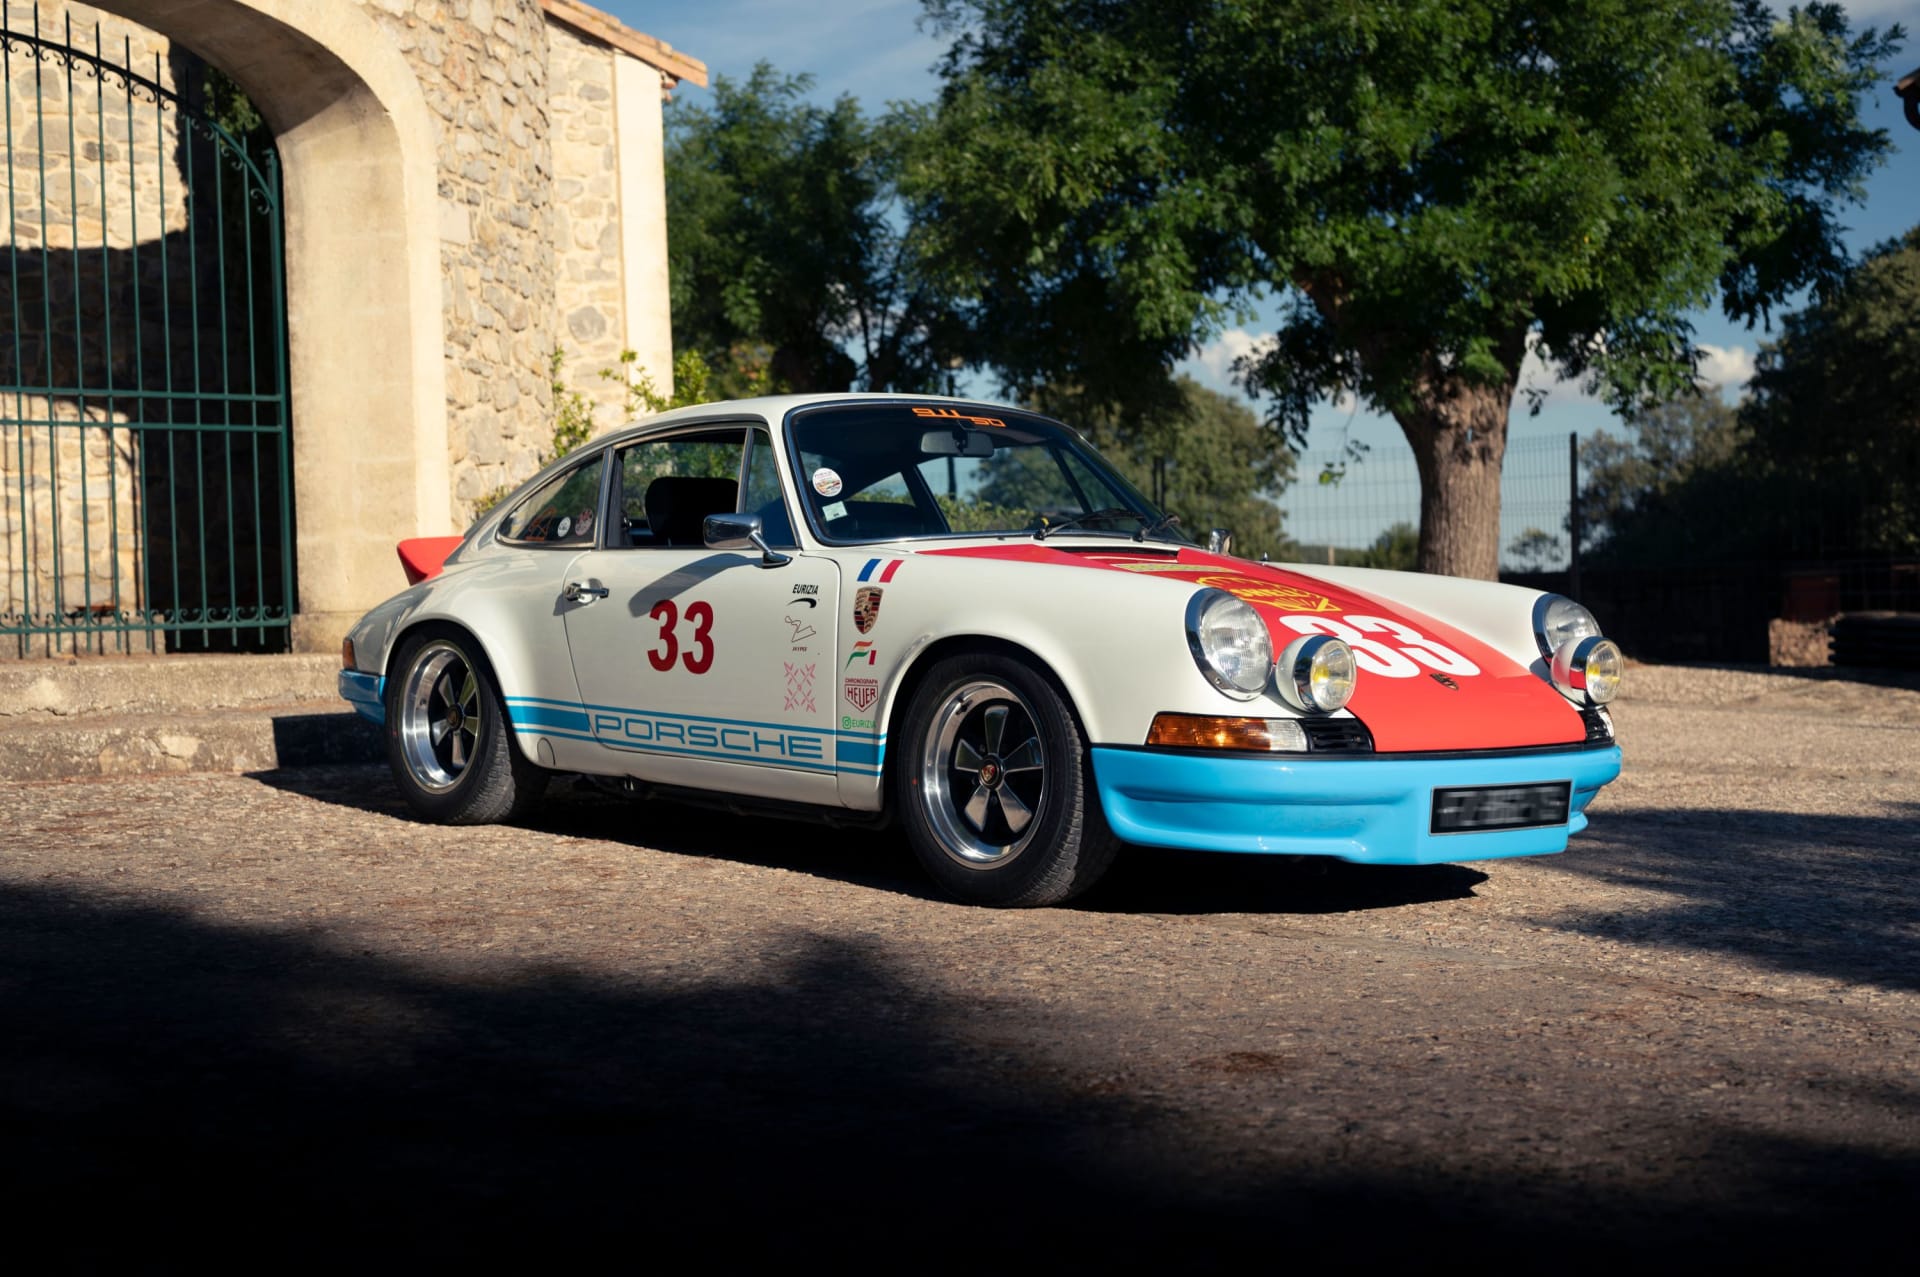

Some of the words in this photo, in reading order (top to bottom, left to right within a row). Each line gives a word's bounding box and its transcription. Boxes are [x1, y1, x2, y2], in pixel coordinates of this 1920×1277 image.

[792, 583, 819, 595] EURIZIA
[647, 600, 715, 675] 33
[1279, 614, 1481, 679] 33
[847, 686, 877, 708] HEUER
[595, 714, 824, 760] PORSCHE
